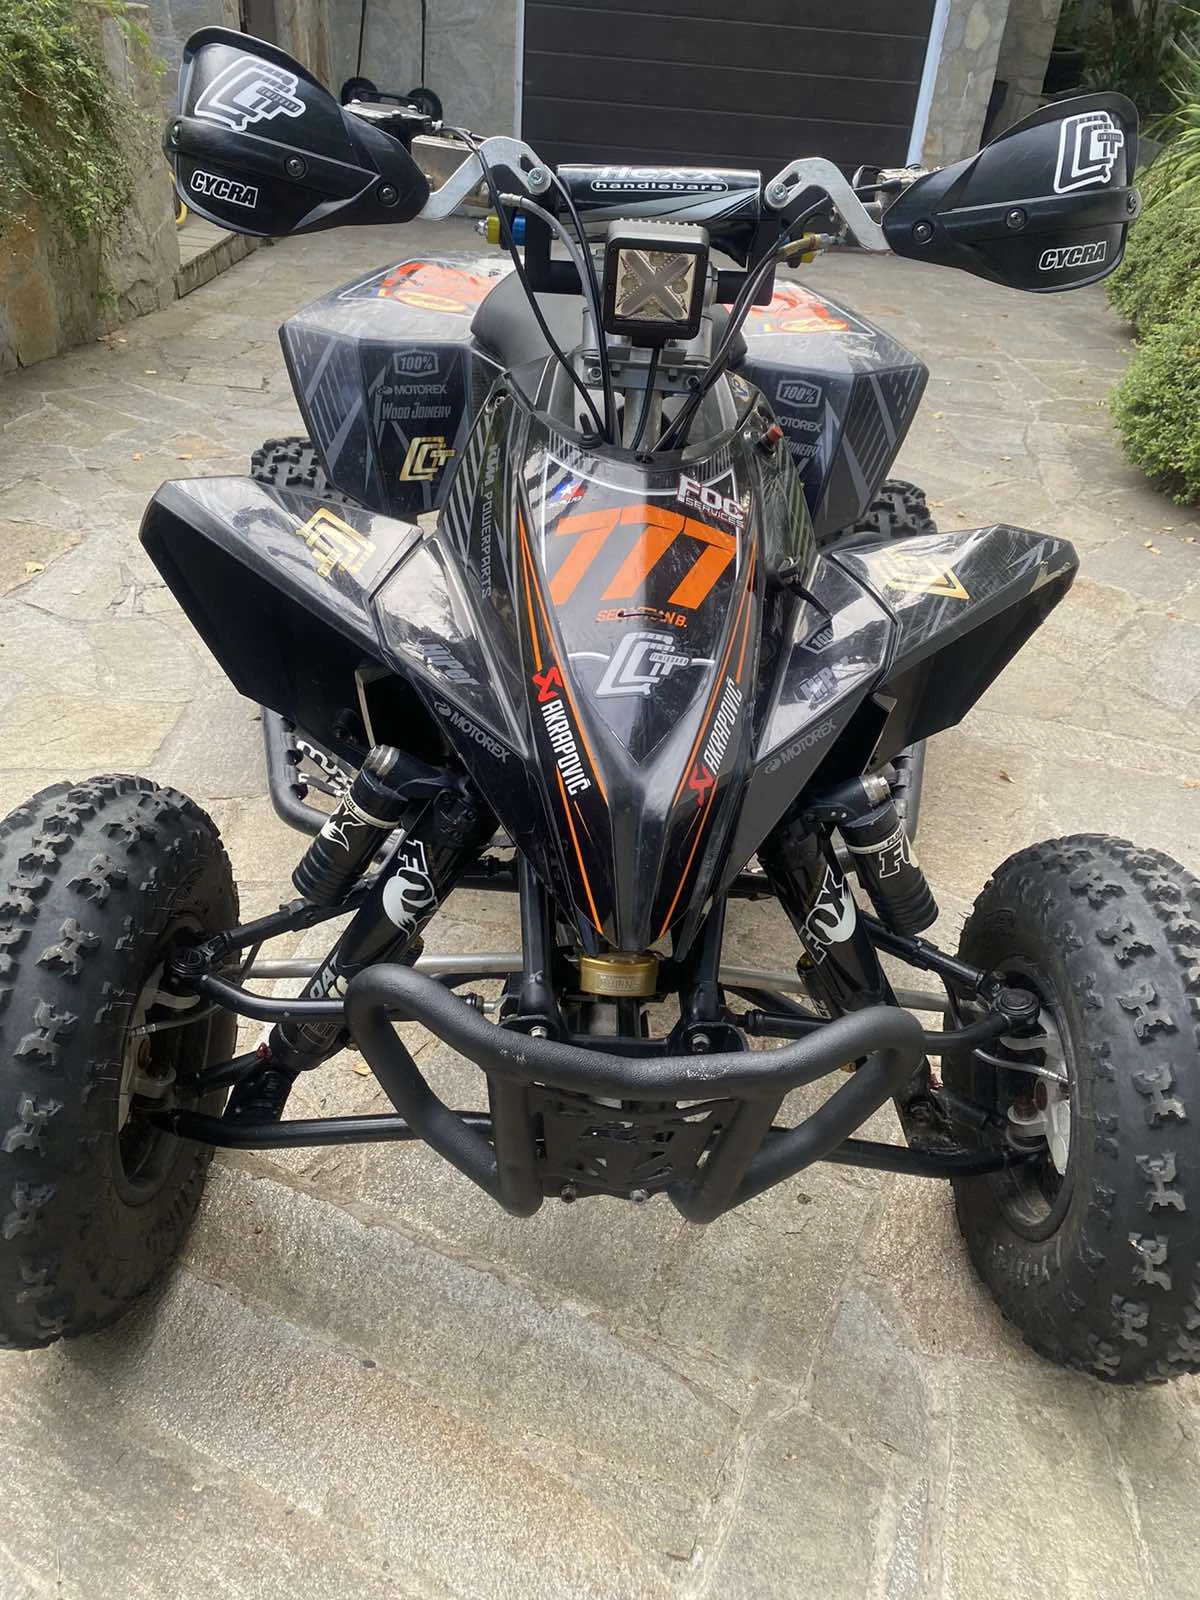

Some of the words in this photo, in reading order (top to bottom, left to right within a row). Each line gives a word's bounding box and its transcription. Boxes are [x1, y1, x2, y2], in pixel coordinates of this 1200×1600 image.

[190, 170, 259, 208] CYCRA
[595, 181, 724, 192] handlebars
[1038, 241, 1107, 271] CYCRA
[400, 355, 434, 371] 100%
[393, 384, 449, 395] MOTOREX
[782, 384, 816, 404] 100%
[686, 498, 745, 528] SERVICES
[481, 490, 493, 600] POWERPARTS
[549, 503, 737, 610] 777
[450, 710, 511, 763] MOTOREX
[780, 718, 837, 764] MOTOREX
[799, 864, 856, 965] FOX
